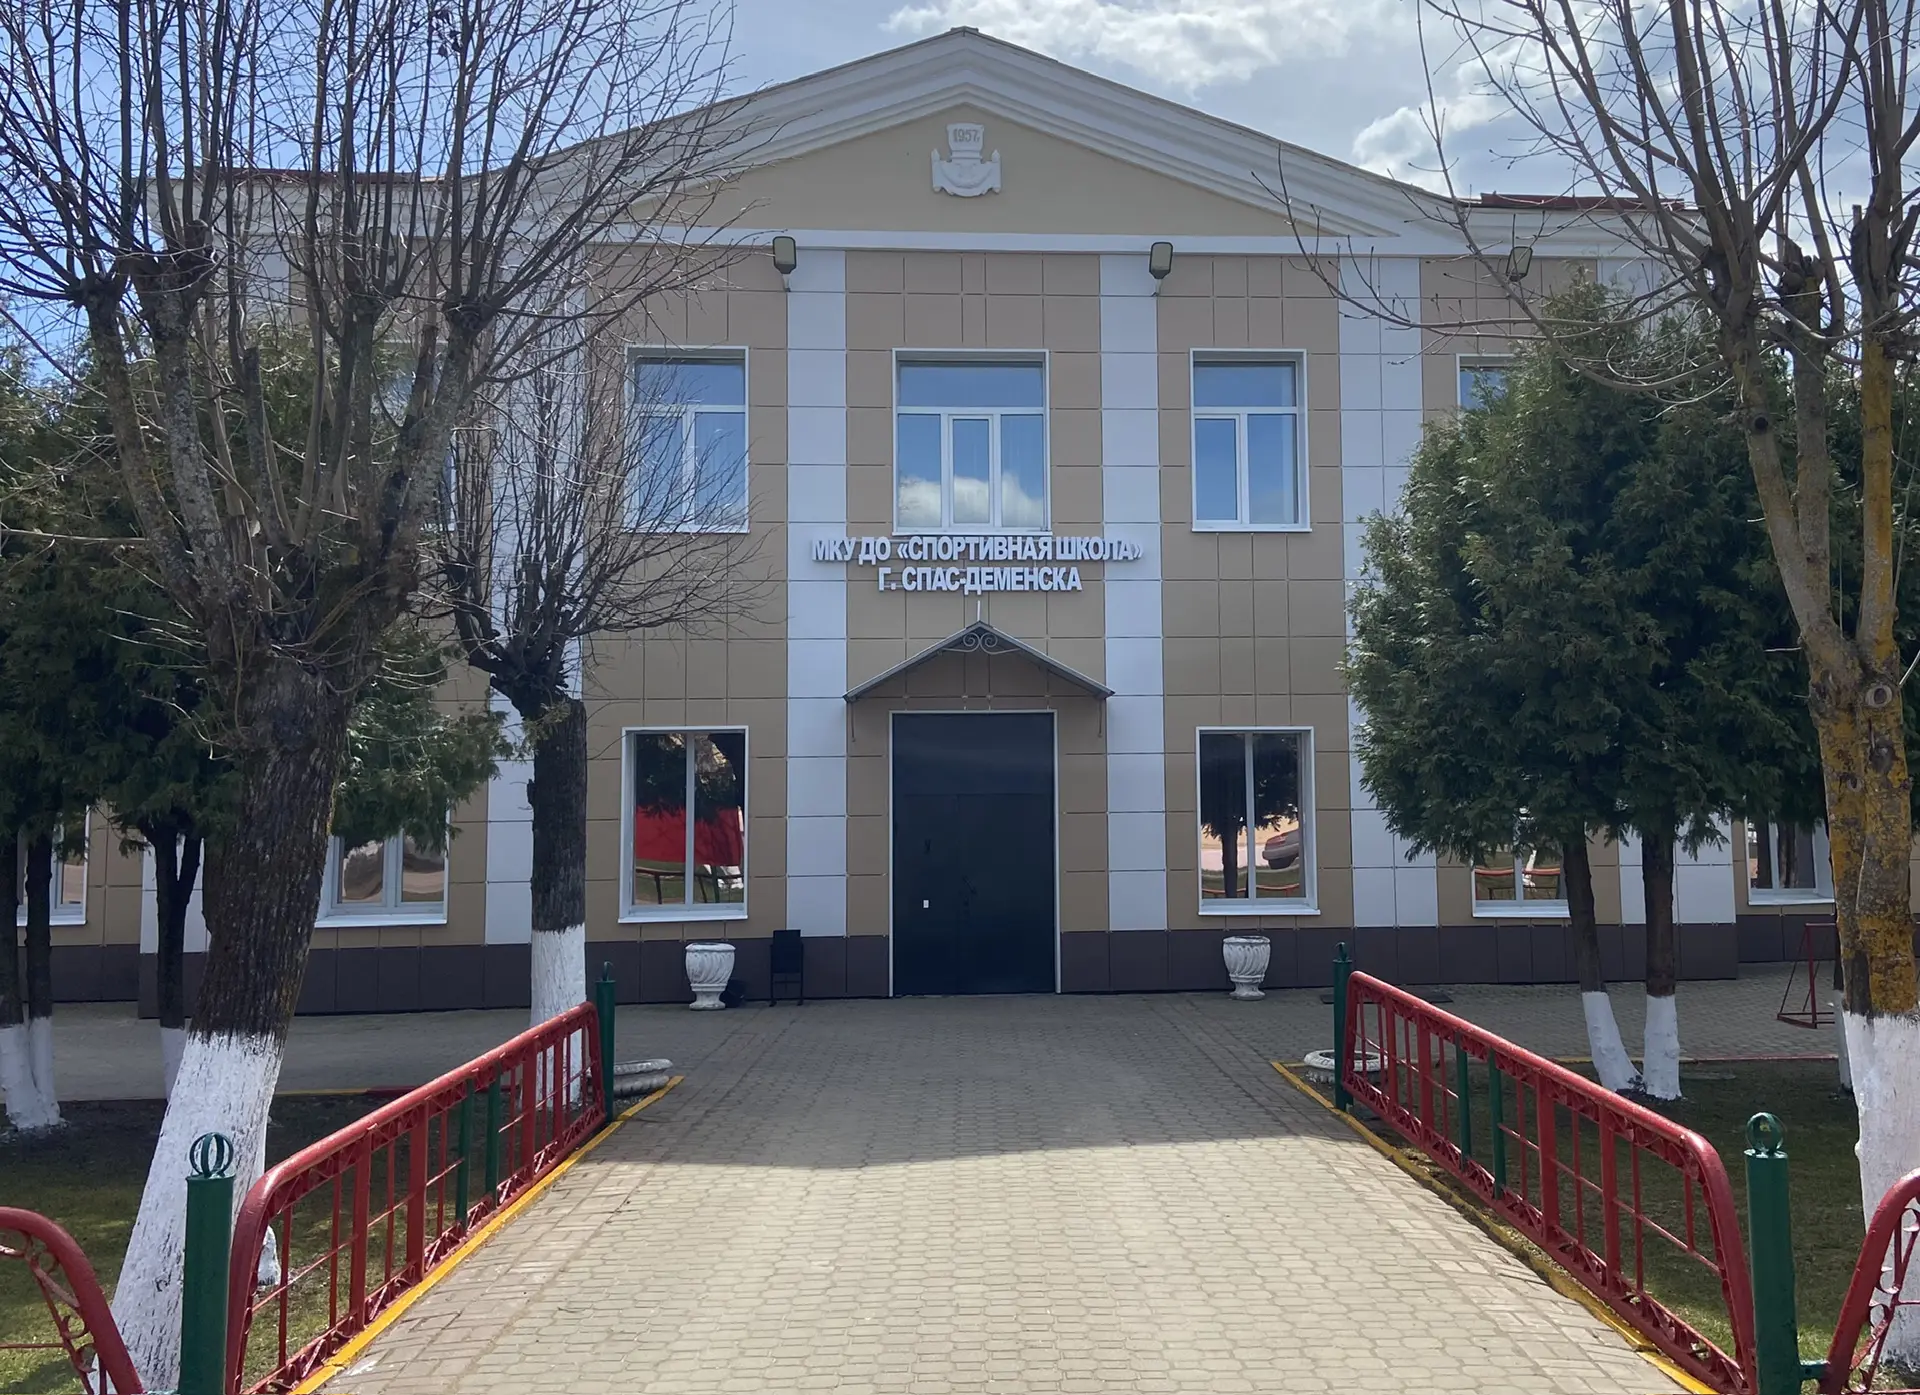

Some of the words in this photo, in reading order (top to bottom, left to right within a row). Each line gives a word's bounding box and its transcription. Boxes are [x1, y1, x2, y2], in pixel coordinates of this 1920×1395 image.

[812, 538, 857, 561] МКУ
[858, 537, 892, 565] ДО
[897, 537, 1053, 561] «СПОРТИВНАЯ
[1055, 537, 1143, 561] ШКОЛА»
[878, 568, 897, 591] Г.
[902, 566, 1083, 595] СПАС-ДЕМЕНСКА
